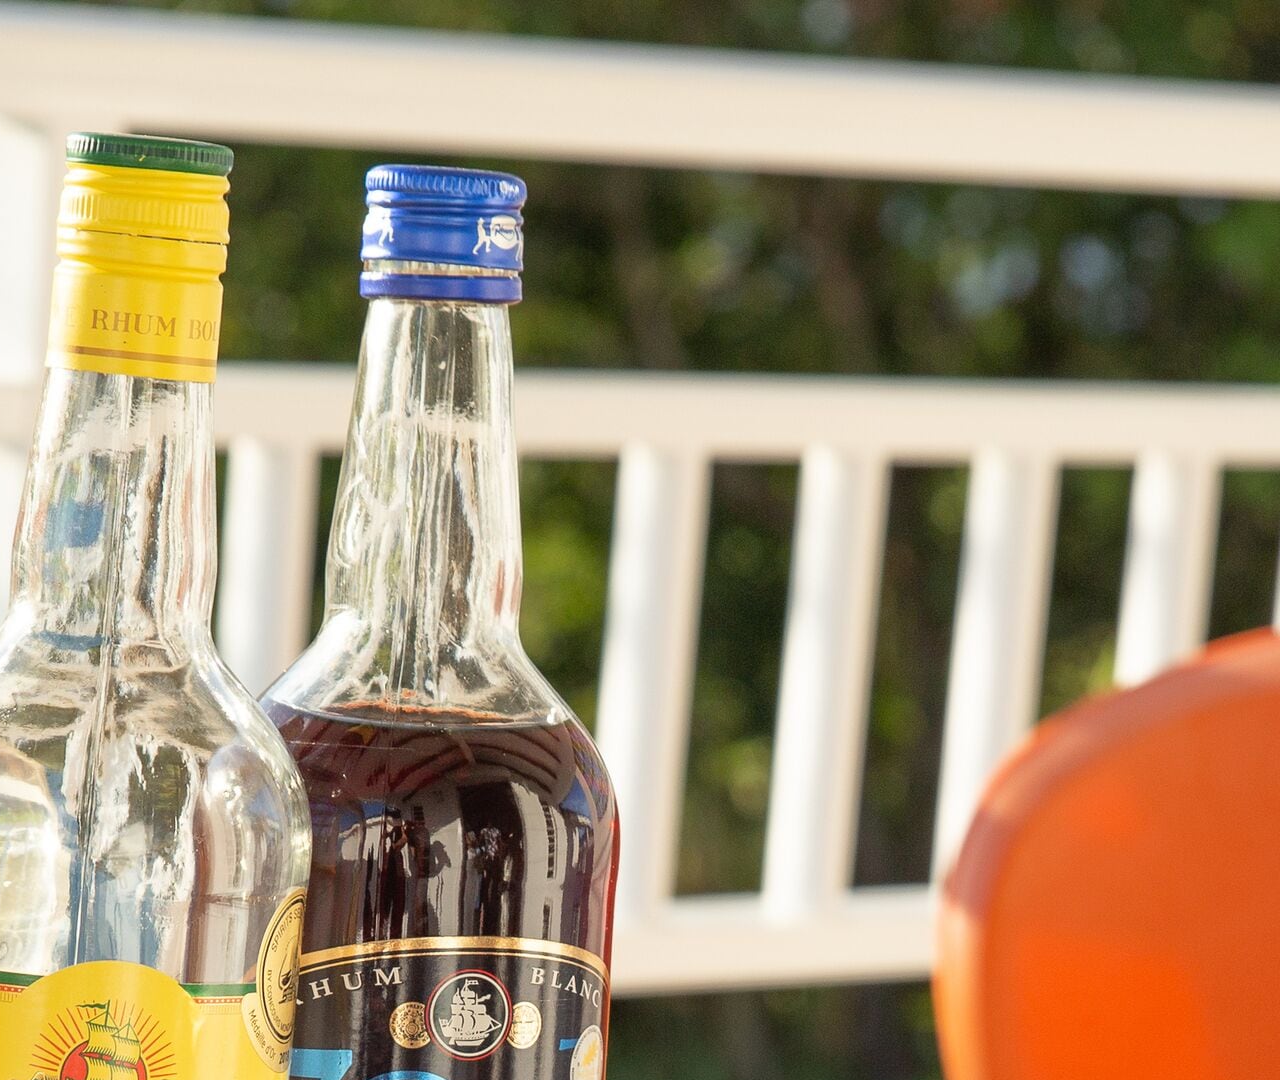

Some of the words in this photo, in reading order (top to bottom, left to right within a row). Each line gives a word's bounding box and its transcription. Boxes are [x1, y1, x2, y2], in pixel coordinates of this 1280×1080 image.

[91, 309, 177, 337] RHUM
[296, 966, 403, 1005] HUM
[530, 967, 602, 1008] BLANC
